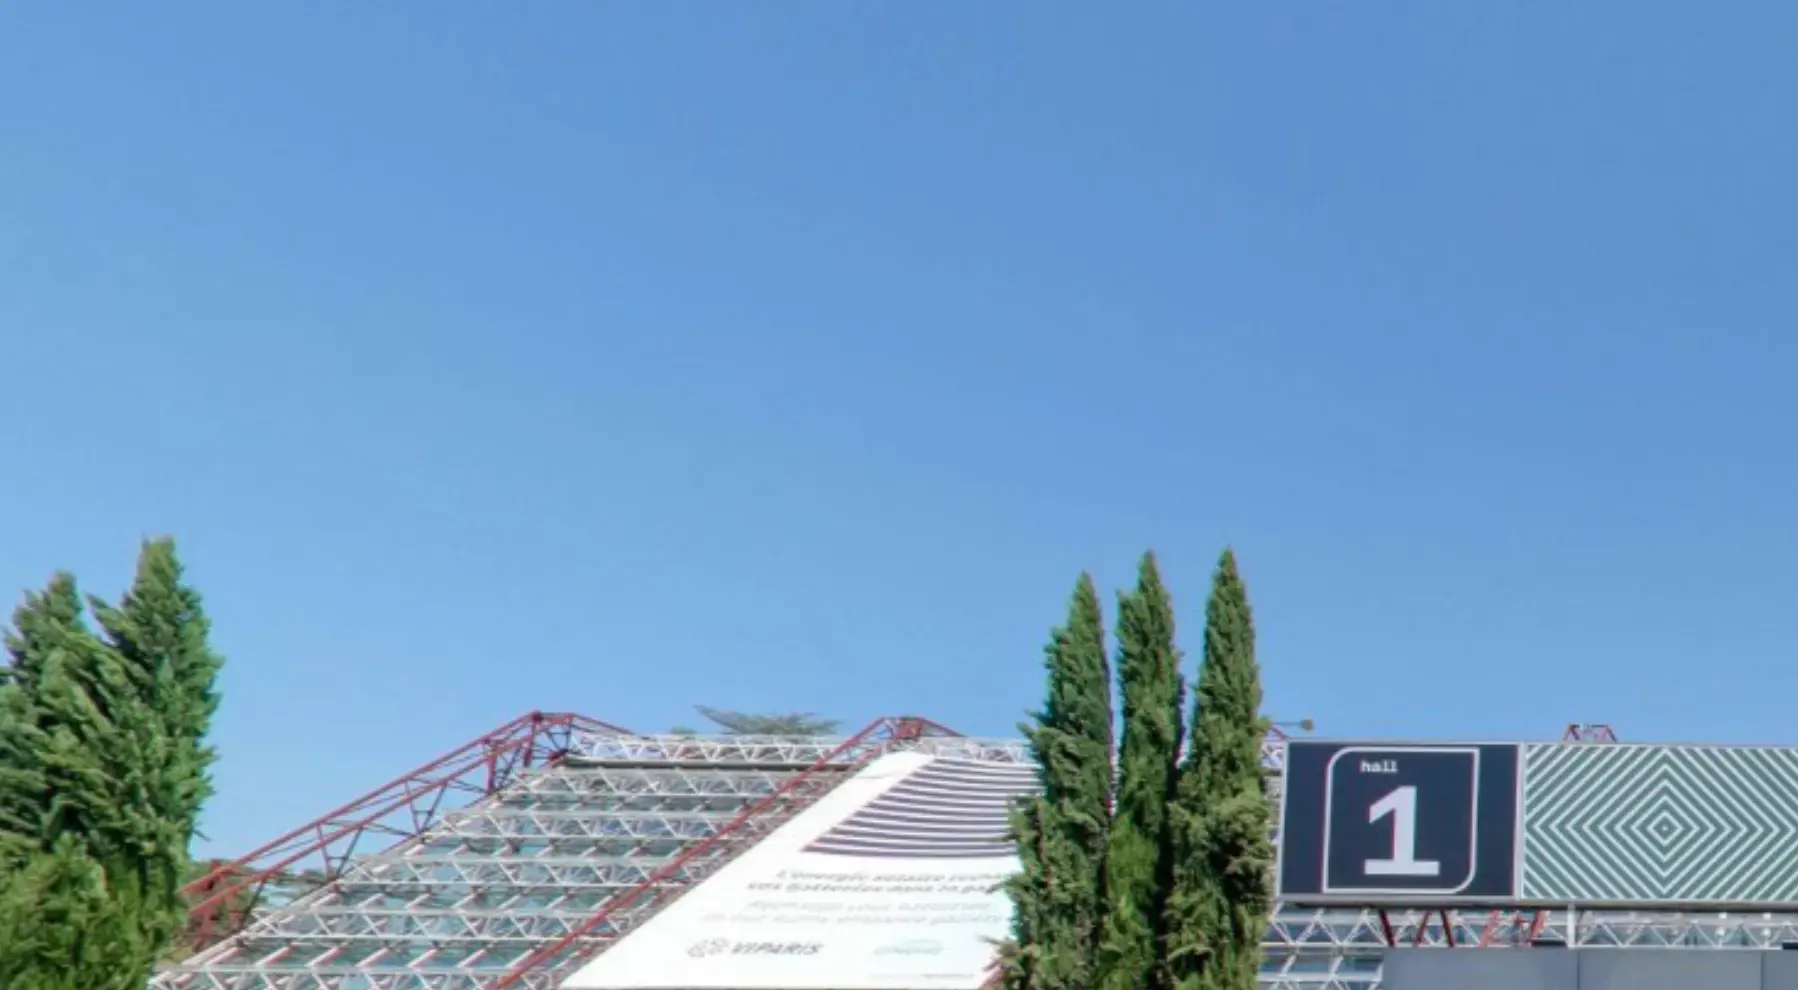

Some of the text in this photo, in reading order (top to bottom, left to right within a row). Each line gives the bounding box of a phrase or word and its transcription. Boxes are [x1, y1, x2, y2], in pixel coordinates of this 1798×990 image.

[1359, 760, 1398, 773] hall
[1363, 785, 1441, 876] 1
[731, 941, 824, 956] VIPARIS
